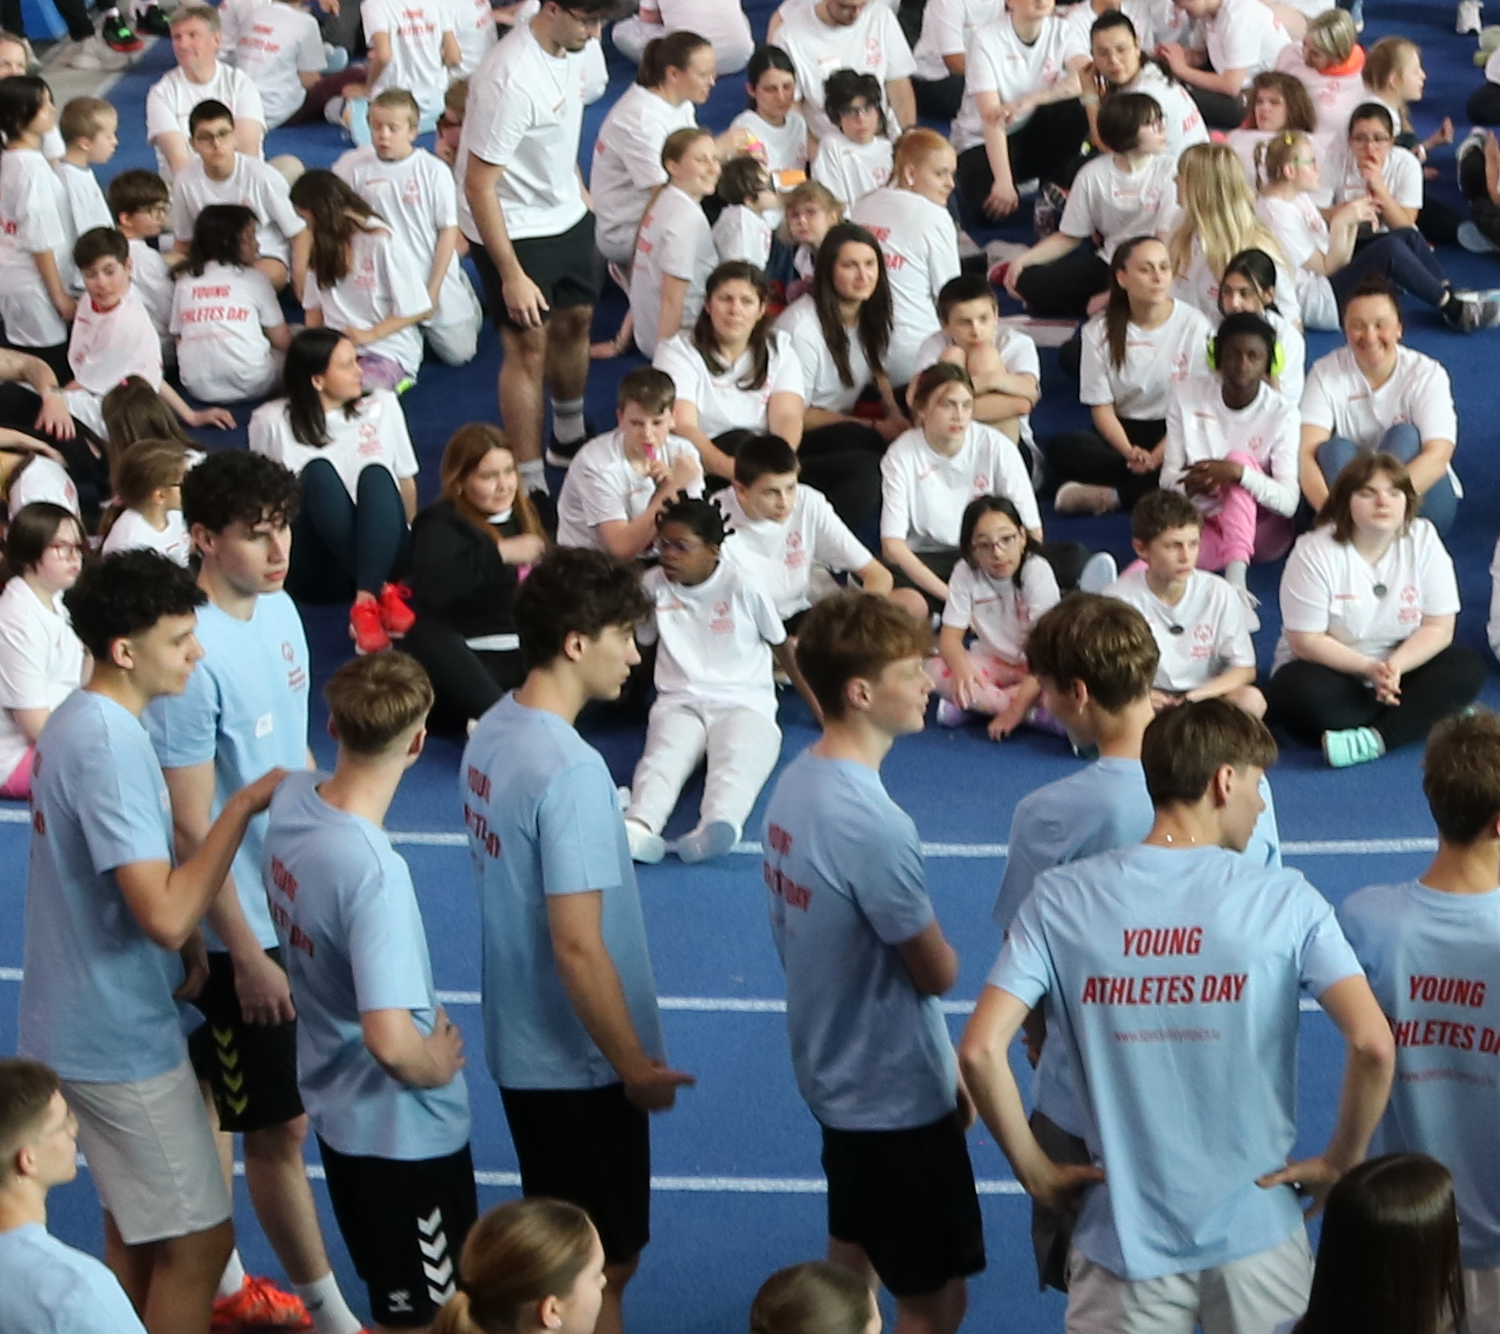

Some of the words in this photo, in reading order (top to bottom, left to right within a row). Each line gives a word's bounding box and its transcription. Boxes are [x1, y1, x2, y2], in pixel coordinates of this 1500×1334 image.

[1122, 927, 1203, 958] YOUNG
[1081, 975, 1196, 1005] ATHLETES
[1200, 974, 1249, 1003] DAY
[1409, 974, 1487, 1008] YOUNG
